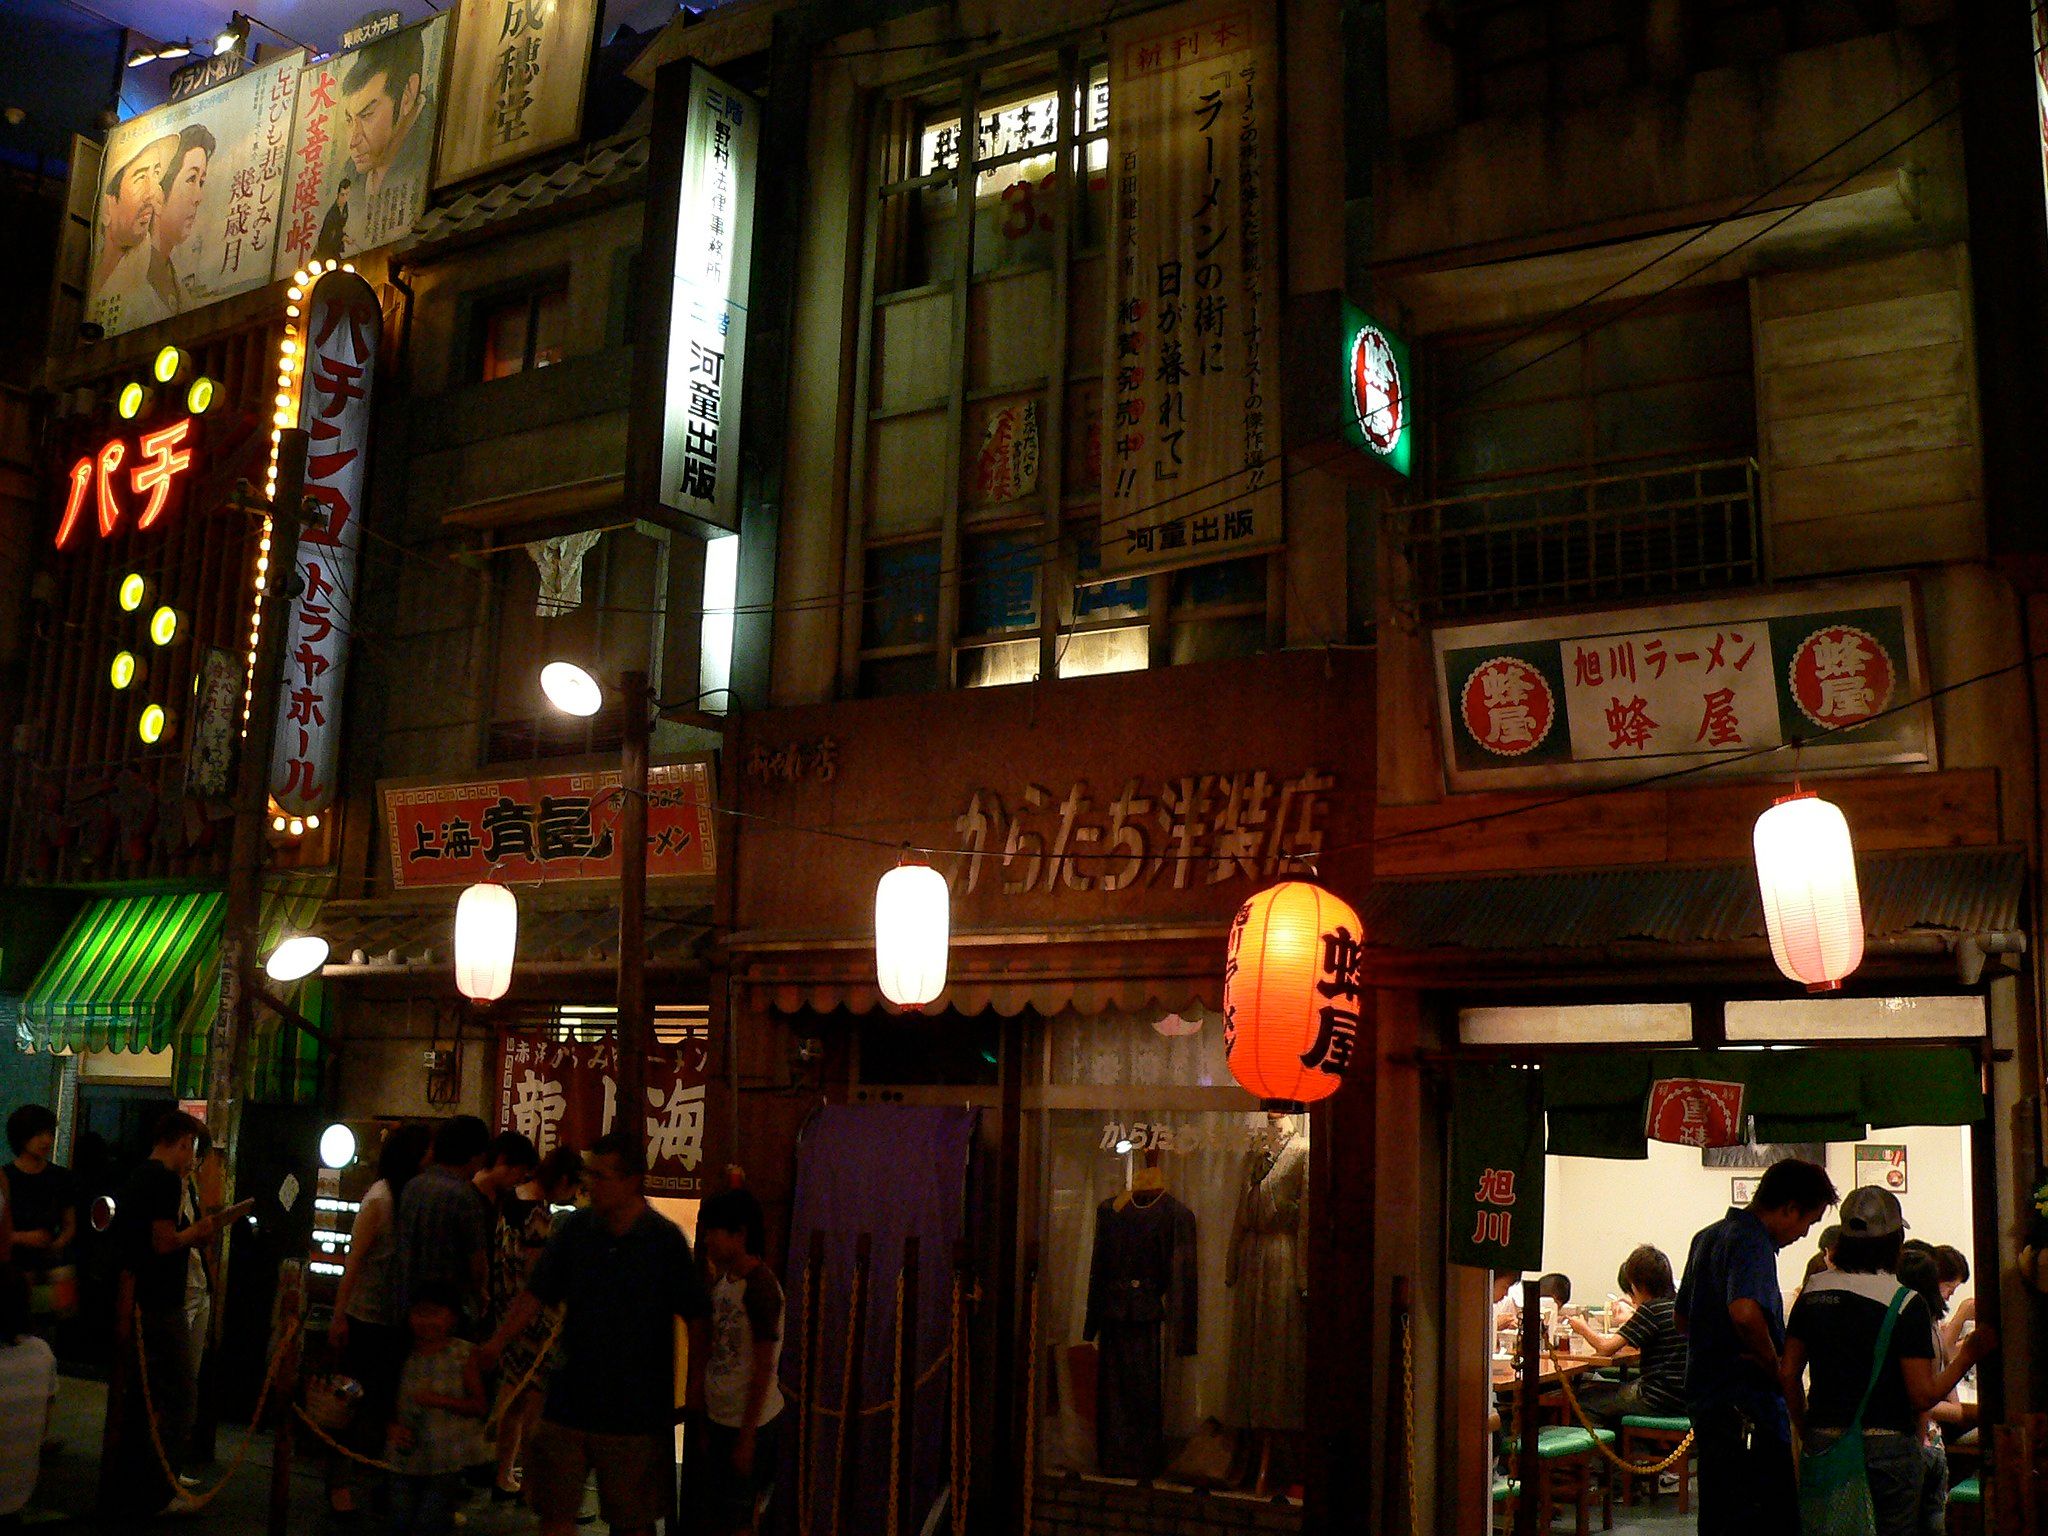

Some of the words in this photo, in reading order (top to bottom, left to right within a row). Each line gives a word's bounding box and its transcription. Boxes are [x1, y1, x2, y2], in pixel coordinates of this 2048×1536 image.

[1137, 22, 1238, 69] 新刊本
[284, 71, 337, 269] 大菩薩峠
[680, 339, 725, 504] 河童出版
[54, 417, 193, 550] パチ
[1127, 508, 1255, 554] 河童出版
[287, 562, 334, 801] トラヤホール
[1573, 632, 1757, 687] 旭川ラーメン
[1812, 634, 1875, 718] 蜂屋
[1480, 664, 1538, 745] 蜂屋
[946, 767, 1335, 895] からたち洋装店
[1471, 1167, 1517, 1247] 旭川
